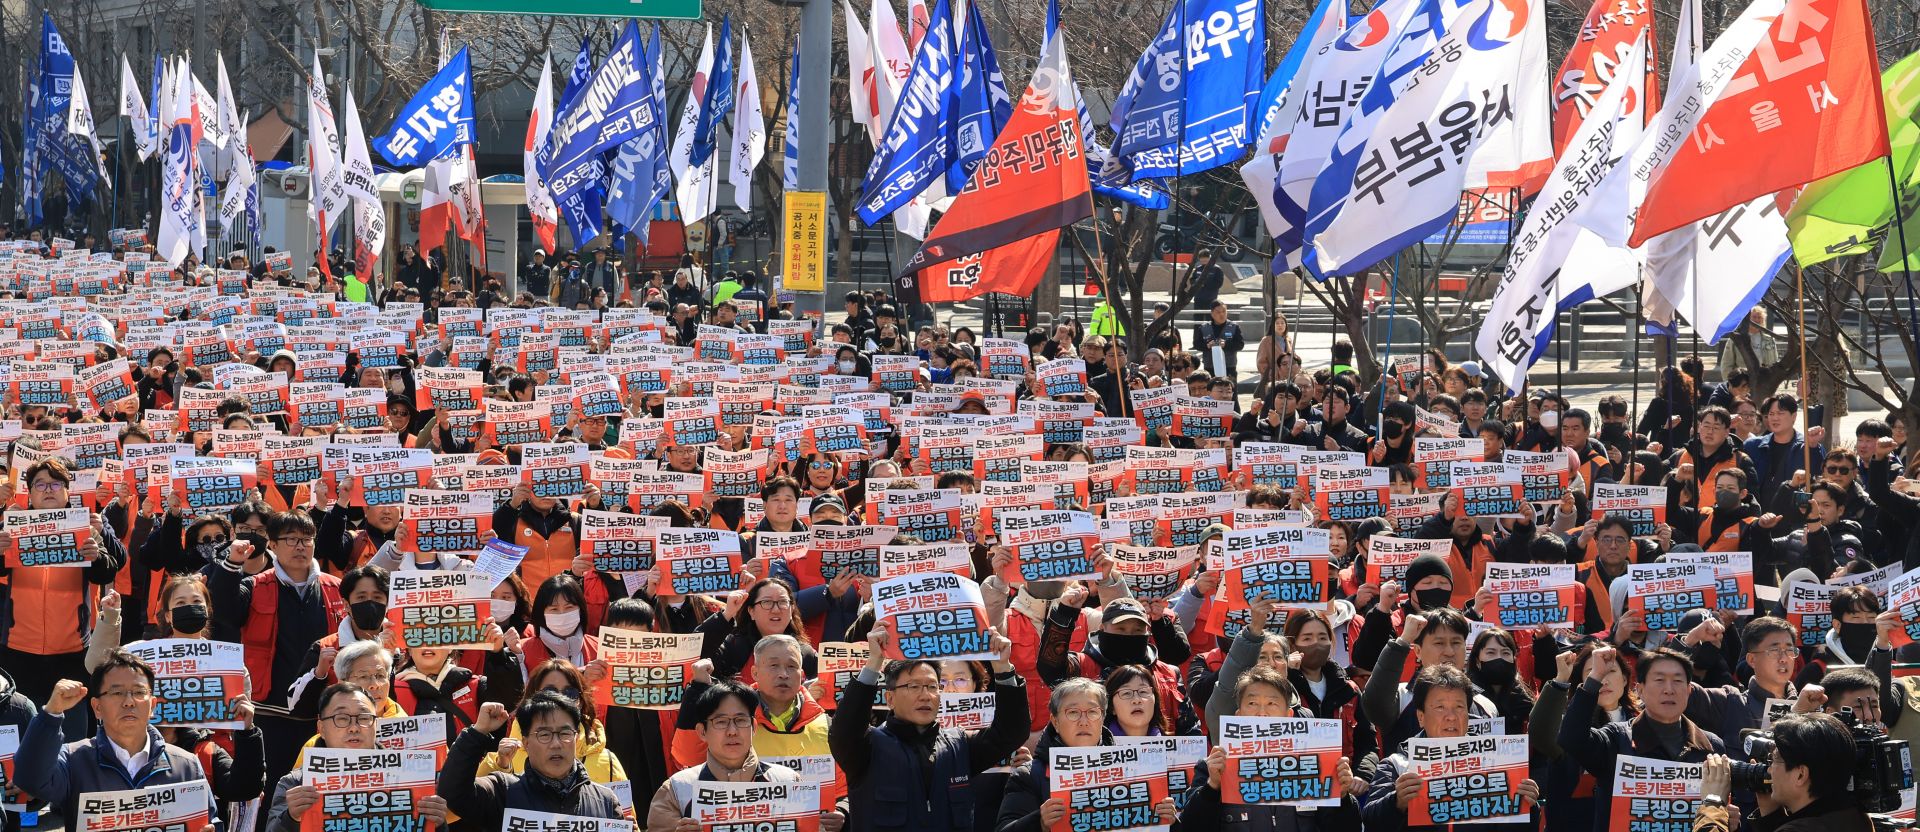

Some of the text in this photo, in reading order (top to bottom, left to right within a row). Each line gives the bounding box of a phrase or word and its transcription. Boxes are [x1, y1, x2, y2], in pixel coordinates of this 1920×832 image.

[793, 212, 803, 240] 공사중
[807, 213, 818, 259] 서소문고가
[20, 381, 61, 392] 투쟁으로
[21, 393, 68, 404] 쟁취하자!
[1183, 416, 1222, 425] 투쟁으로
[524, 445, 574, 458] 모든 노동자의
[1129, 450, 1177, 459] 모든 노동자의
[176, 458, 233, 467] 모든 노동자의
[527, 456, 566, 468] 노동기본권
[1453, 465, 1505, 476] 모든 노동자의
[533, 466, 581, 482] 투쟁으로
[1136, 469, 1180, 480] 투쟁으로
[1319, 468, 1371, 479] 모든 노동자의
[1456, 476, 1496, 486] 노동기본권
[187, 478, 242, 490] 투쟁으로
[1136, 481, 1187, 493] 쟁취하자!
[1321, 479, 1362, 490] 노동기본권
[190, 491, 251, 504] 쟁취하자!
[1328, 490, 1377, 504] 투쟁으로
[1463, 486, 1513, 500] 투쟁으로
[1329, 504, 1385, 519] 쟁취하자!
[1465, 500, 1520, 515] 쟁취하자!
[7, 511, 66, 525] 모든 노동자의
[585, 516, 645, 527] 모든 노동자의
[1005, 512, 1072, 530] 모든 노동자의
[10, 523, 56, 536] 노동기본권
[587, 528, 633, 538] 노동기본권
[660, 531, 720, 545] 모든 노동자의
[1009, 527, 1061, 543] 노동기본권
[18, 533, 75, 550] 투쟁으로
[594, 541, 650, 554] 투쟁으로
[1228, 530, 1302, 549] 모든 노동자의
[664, 544, 710, 558] 노동기본권
[1018, 539, 1083, 560] 투쟁으로
[1232, 546, 1289, 564] 노동기본권
[672, 557, 730, 575] 투쟁으로
[1022, 556, 1094, 579] 쟁취하자!
[1242, 561, 1313, 584] 투쟁으로
[1488, 567, 1550, 579] 모든 노동자의
[1632, 564, 1696, 580] 모든 노동자의
[392, 574, 466, 590] 모든 노동자의
[675, 574, 739, 593] 쟁취하자!
[878, 576, 961, 596] 모든 노동자의
[1491, 579, 1539, 591] 노동기본권
[1635, 578, 1685, 593] 노동기본권
[396, 589, 453, 605] 노동기본권
[883, 593, 948, 612] 노동기본권
[1499, 591, 1557, 608] 투쟁으로
[1644, 590, 1705, 610] 투쟁으로
[405, 604, 475, 625] 투쟁으로
[895, 609, 975, 634] 투쟁으로
[1501, 607, 1566, 625] 쟁취하자!
[602, 635, 677, 649] 모든 노동자의
[900, 631, 988, 658] 쟁취하자!
[160, 644, 213, 660] 노동자의
[605, 651, 662, 663] 노동기본권
[613, 667, 683, 684] 투쟁으로
[614, 687, 682, 704] 쟁취하자
[946, 696, 995, 713] 노동자의
[1224, 721, 1308, 739] 모든 노동자의
[1228, 738, 1293, 755] 노동기본권
[1413, 739, 1496, 761] 모든 노동자의
[308, 753, 401, 773] 모든 노동자의
[1055, 748, 1138, 771] 모든 노동자의
[1239, 755, 1318, 778] 투쟁으로
[1417, 757, 1482, 778] 노동기본권
[1059, 767, 1123, 788] 노동기본권
[1619, 762, 1701, 780] 모든 노동자의
[312, 772, 384, 791] 노동기본권
[1241, 778, 1331, 802] 쟁취하자!
[1428, 772, 1507, 799] 투쟁으로
[1622, 781, 1685, 795] 노동기본권
[83, 792, 176, 815] 모든 노동자의
[324, 790, 412, 815] 투쟁으로
[697, 786, 787, 805] 모든 노동자의
[1070, 782, 1149, 809] 투쟁으로
[701, 804, 770, 822] 노동기본권
[1430, 793, 1520, 822] 쟁취하자!
[87, 809, 159, 831] 노동기본권
[507, 817, 598, 832] 모든 노동자의
[1072, 804, 1161, 832] 쟁취하자!
